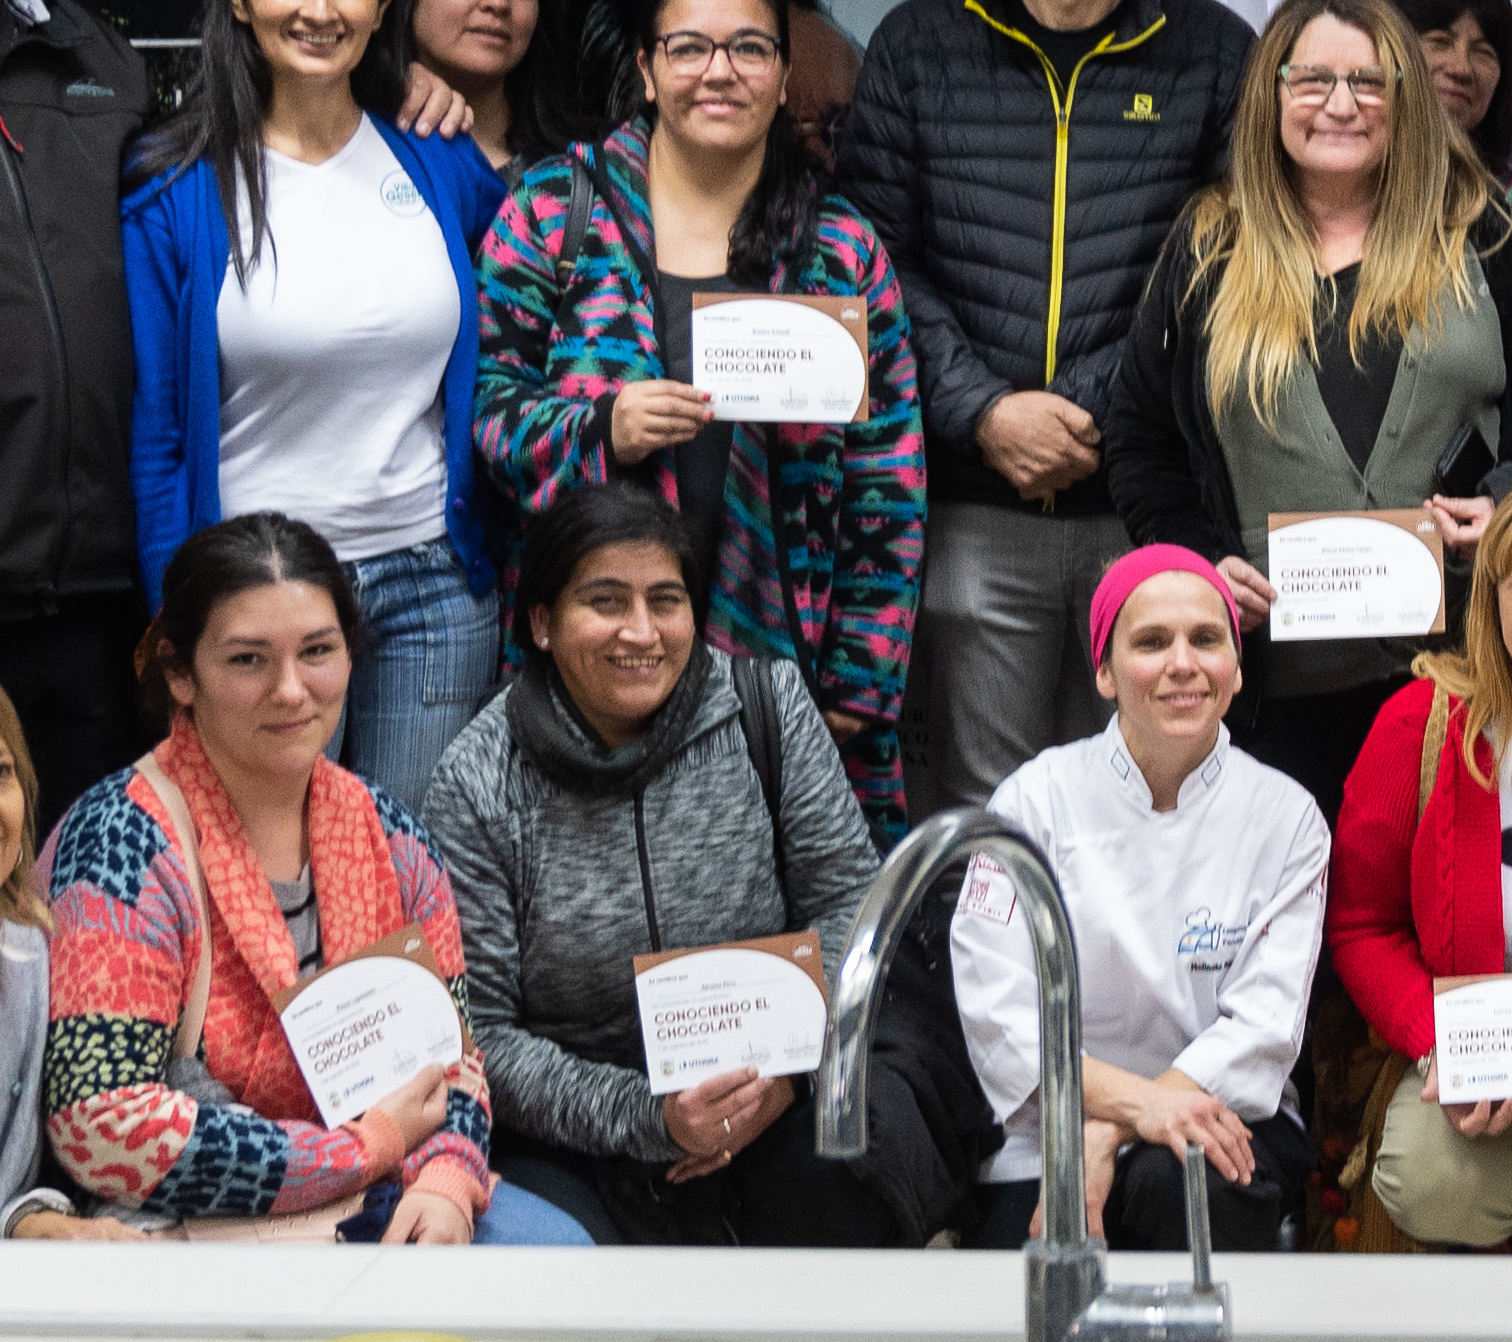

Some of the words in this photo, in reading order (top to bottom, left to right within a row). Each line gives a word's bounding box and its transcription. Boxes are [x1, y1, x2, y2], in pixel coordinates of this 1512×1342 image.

[704, 347, 797, 360] CONOCIENDO
[801, 349, 814, 361] EL
[704, 361, 787, 374] CHOCOLATE
[1281, 566, 1372, 579] CONOCIENDO
[1376, 565, 1389, 577] EL
[1281, 581, 1362, 594] CHOCOLATE
[654, 1000, 752, 1025] CONOCIENDO
[755, 997, 770, 1010] EL
[307, 1011, 386, 1059] CONOCIENDO
[387, 1001, 403, 1018] EL
[656, 1017, 742, 1041] CHOCOLATE
[314, 1028, 384, 1075] CHOCOLATE
